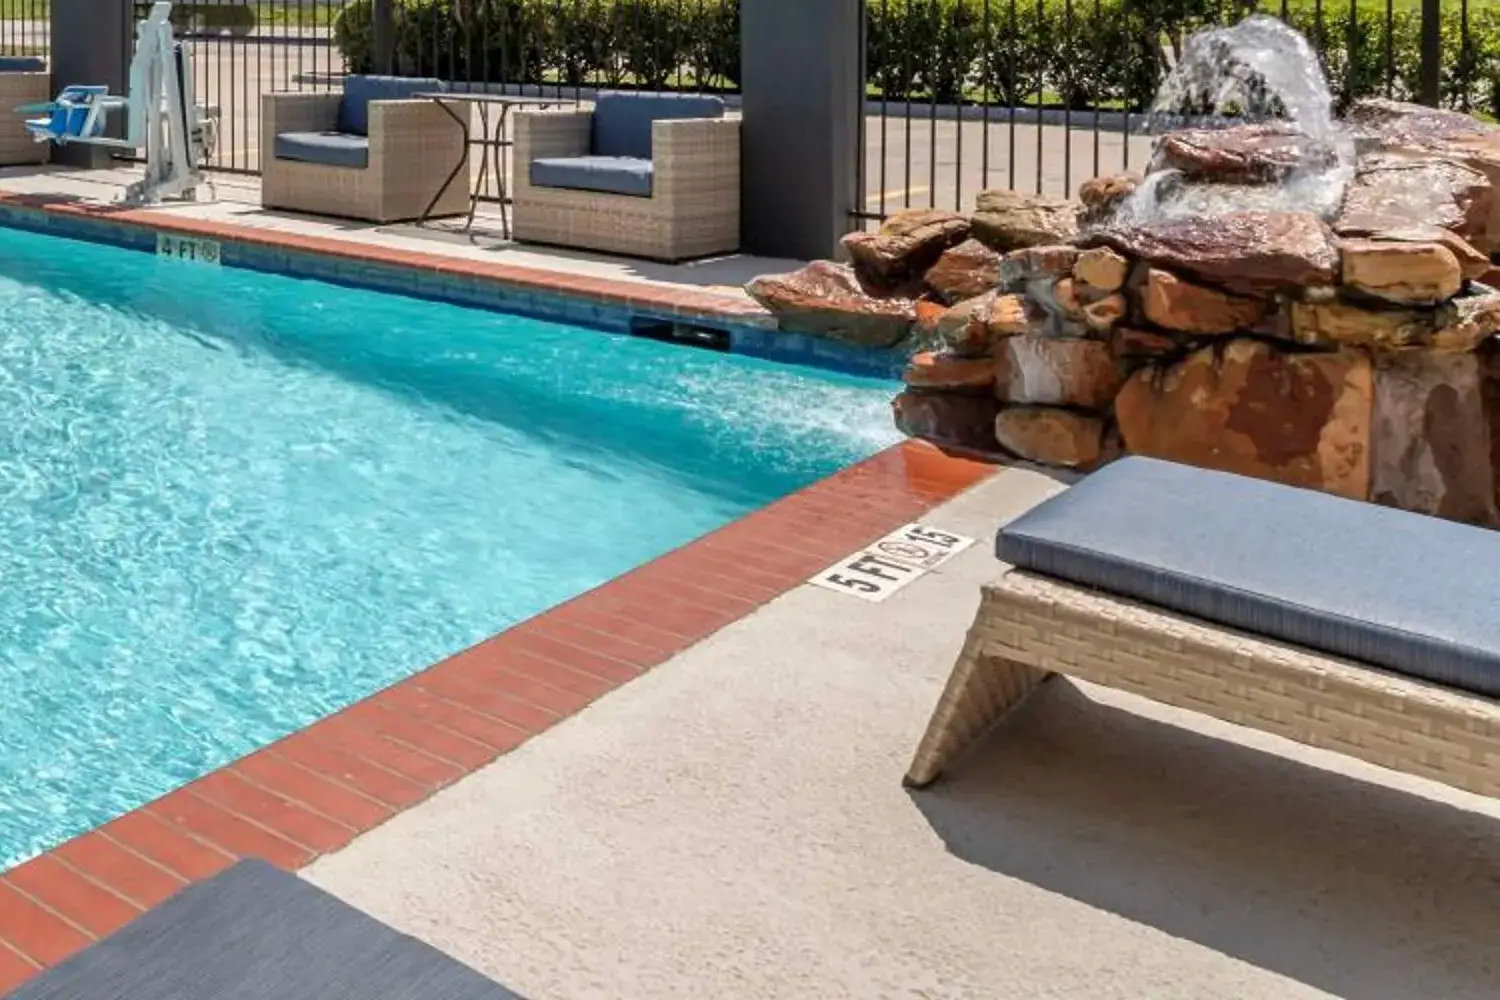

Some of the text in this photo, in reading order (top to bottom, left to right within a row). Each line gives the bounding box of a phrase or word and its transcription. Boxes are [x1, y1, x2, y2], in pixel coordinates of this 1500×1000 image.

[179, 240, 197, 260] FT
[847, 555, 912, 581] FT
[826, 573, 881, 593] 5
